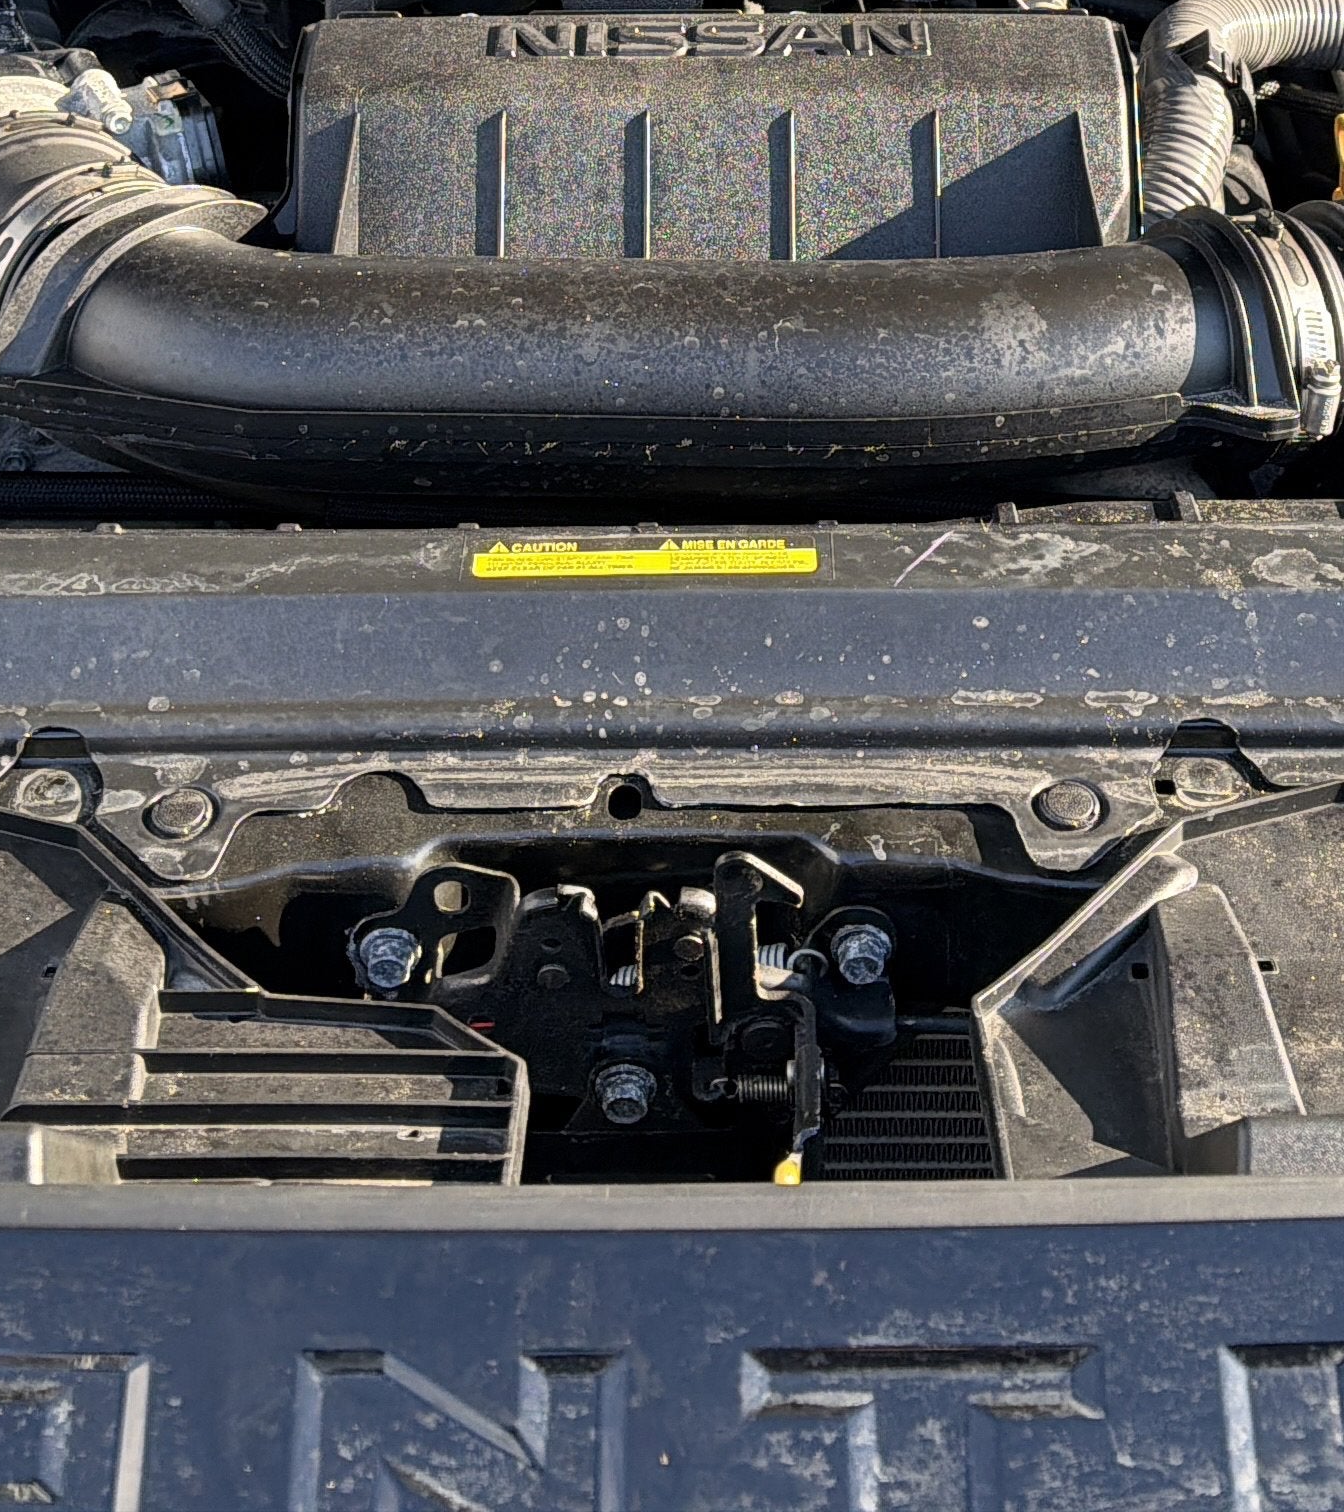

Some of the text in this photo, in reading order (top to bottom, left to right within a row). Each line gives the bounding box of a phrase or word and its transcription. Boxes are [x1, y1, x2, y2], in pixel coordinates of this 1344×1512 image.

[485, 20, 932, 58] NISSAN
[511, 541, 578, 553] CAUTION
[681, 539, 786, 550] MISE EN GARDE
